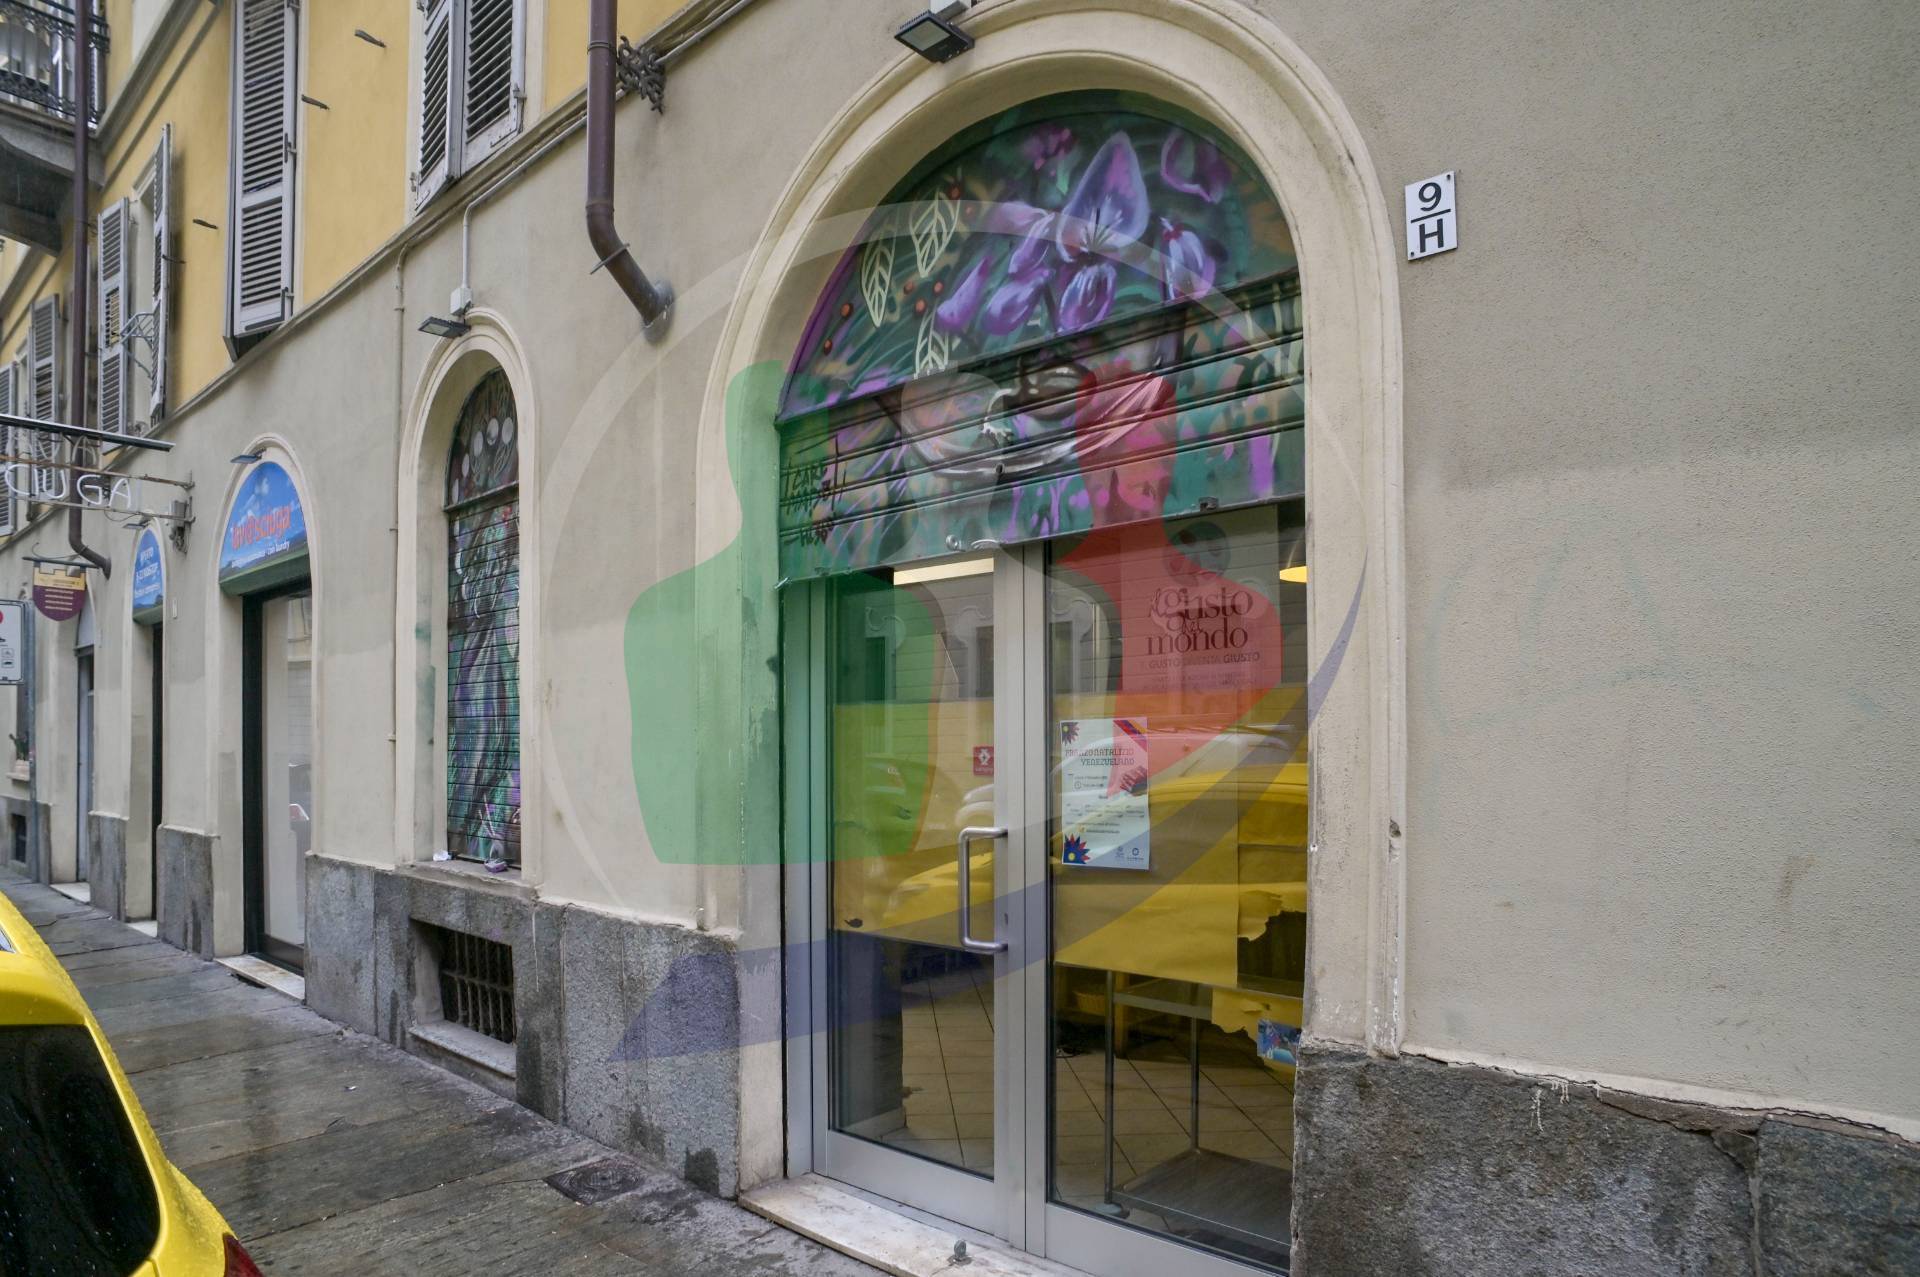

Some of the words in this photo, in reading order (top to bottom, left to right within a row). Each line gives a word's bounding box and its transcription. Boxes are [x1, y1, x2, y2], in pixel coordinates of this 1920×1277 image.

[1418, 182, 1442, 212] 9
[1419, 218, 1444, 253] H
[1146, 617, 1249, 655] mondo
[1223, 651, 1261, 664] GIUSTO
[1080, 757, 1135, 766] VENEZUELANO
